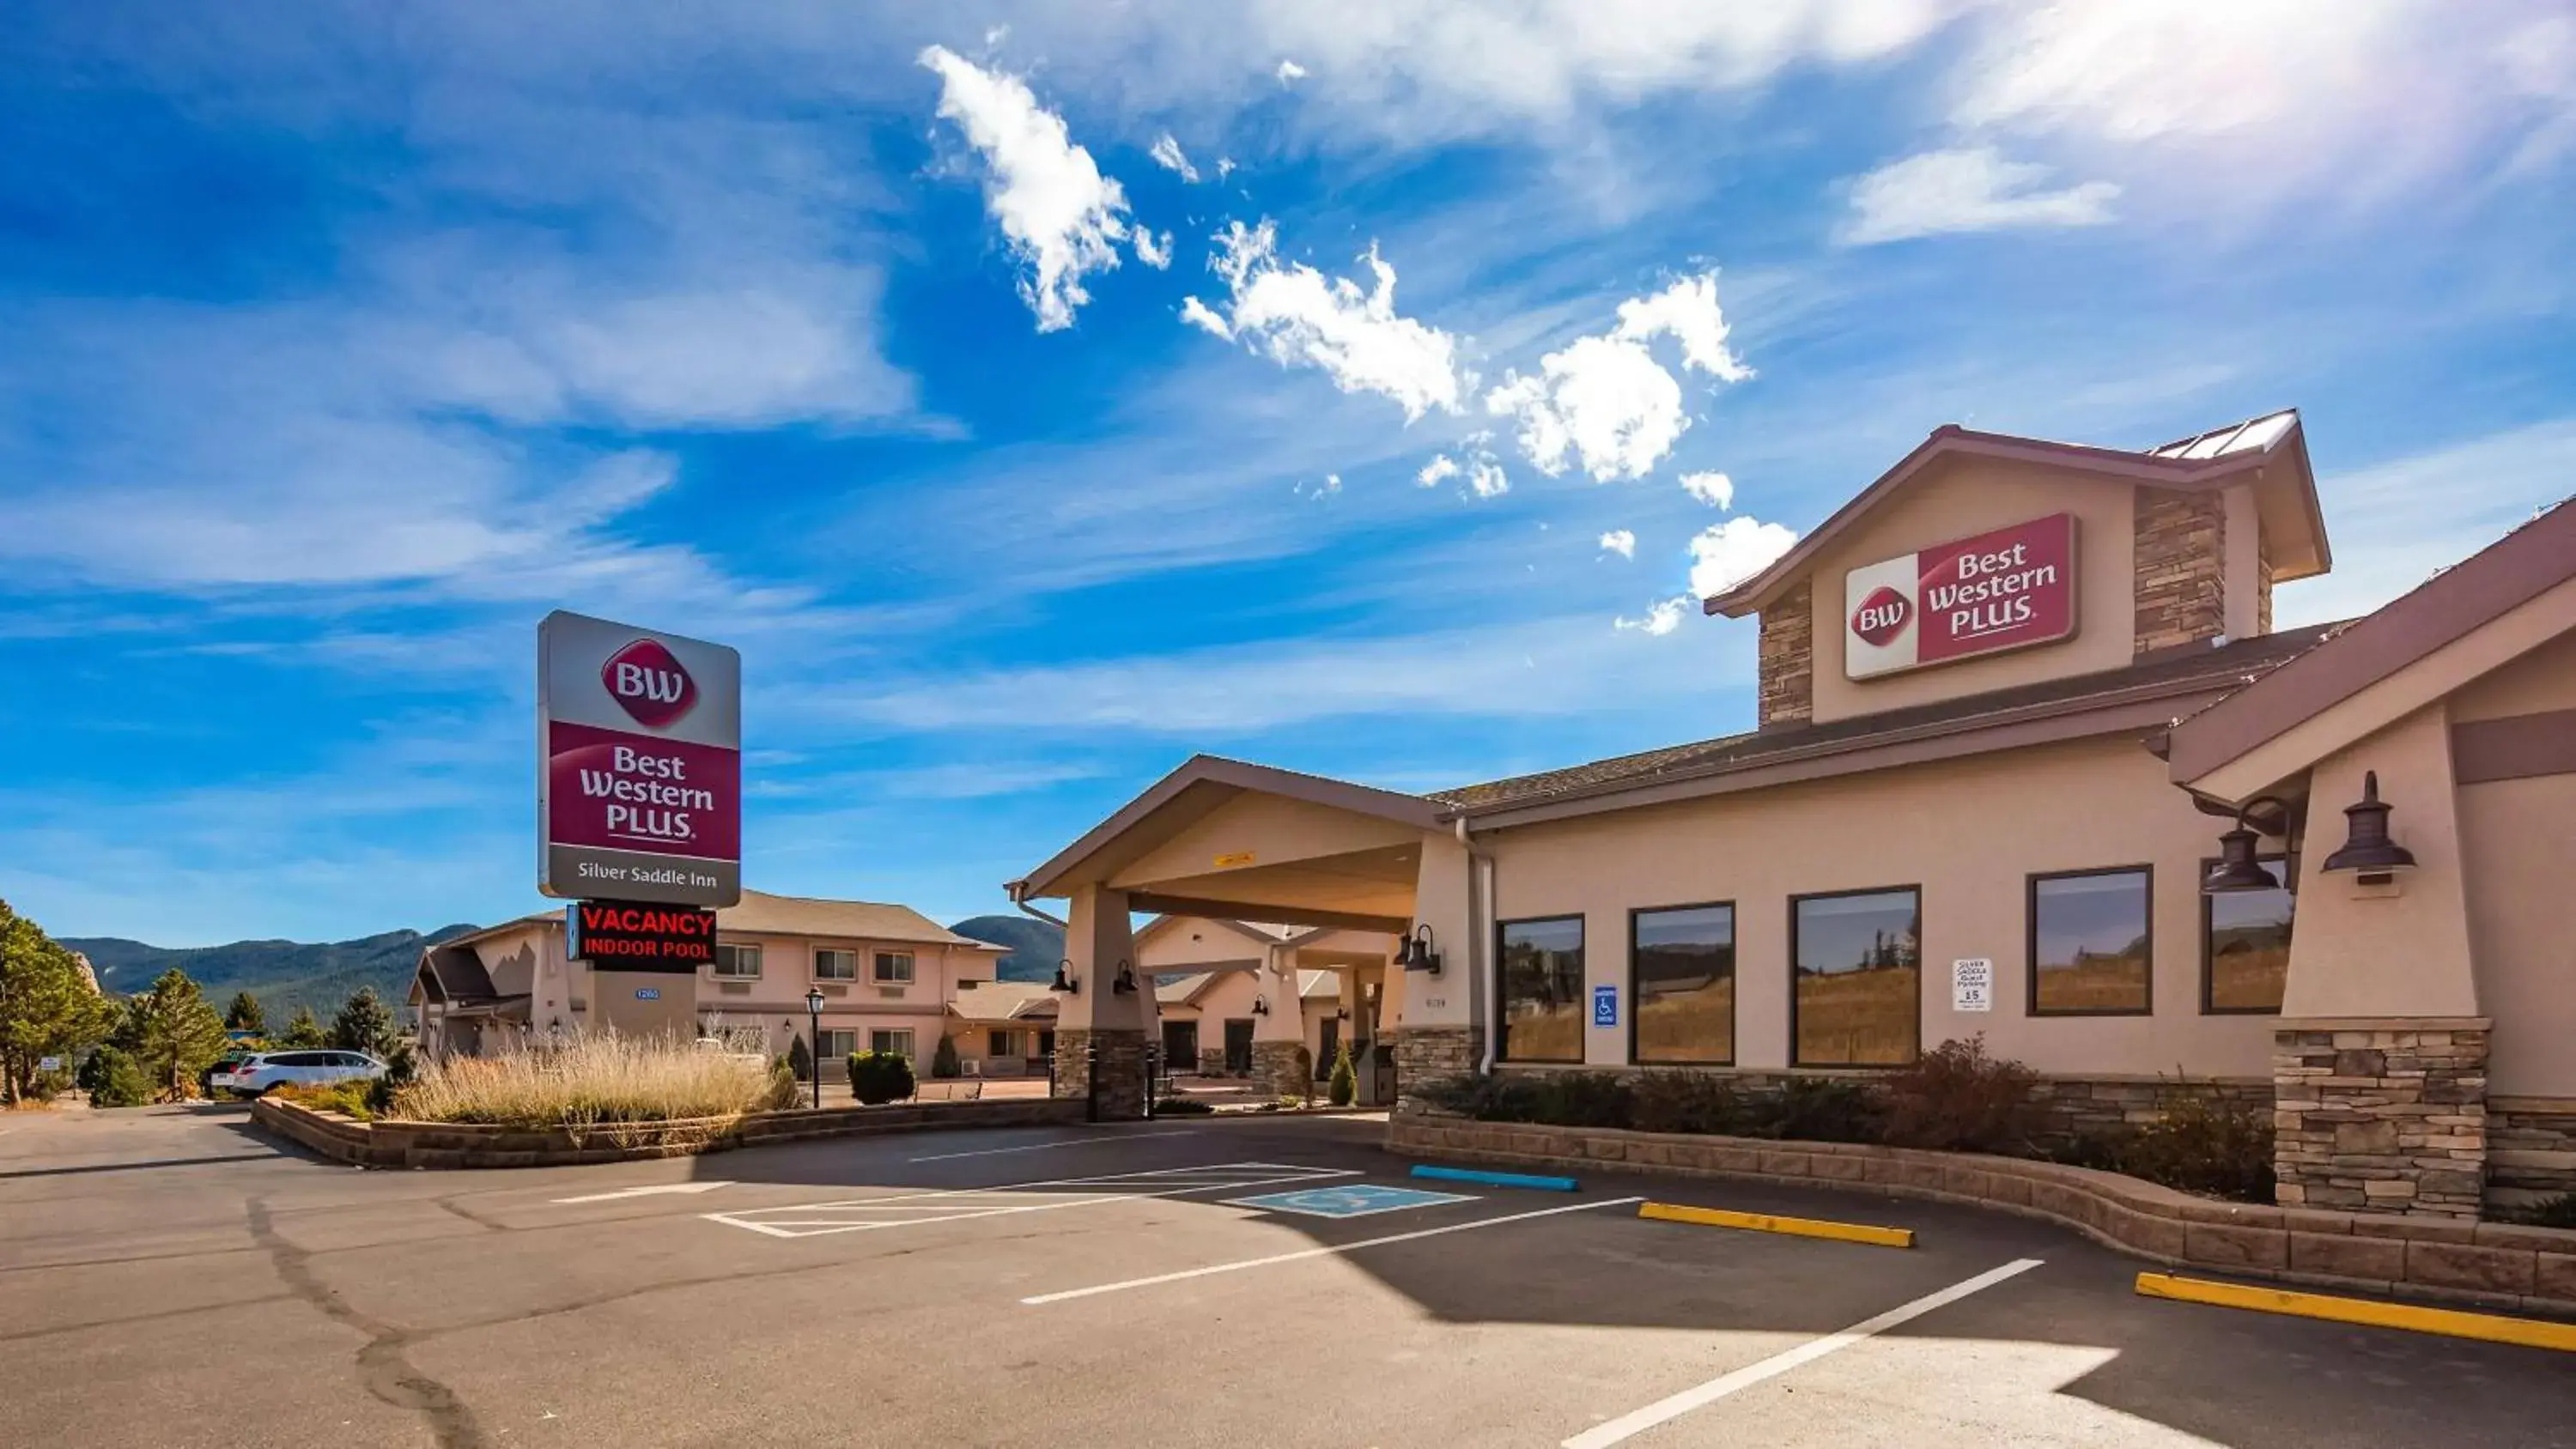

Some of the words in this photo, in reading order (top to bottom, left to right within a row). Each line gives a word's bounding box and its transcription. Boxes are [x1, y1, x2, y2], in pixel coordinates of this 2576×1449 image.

[1959, 543, 2027, 579] Best
[1929, 564, 2057, 612] Western
[1860, 601, 1904, 632] BW
[616, 661, 683, 704] BW
[614, 746, 686, 779] Best
[580, 768, 714, 811] Western
[578, 863, 627, 880] Silver
[631, 867, 686, 885] Saddle
[690, 872, 717, 888] Inn
[582, 906, 714, 936] VACANCY
[585, 937, 657, 955] INDOOR
[663, 943, 711, 959] POOL
[1965, 990, 1979, 1000] 15
